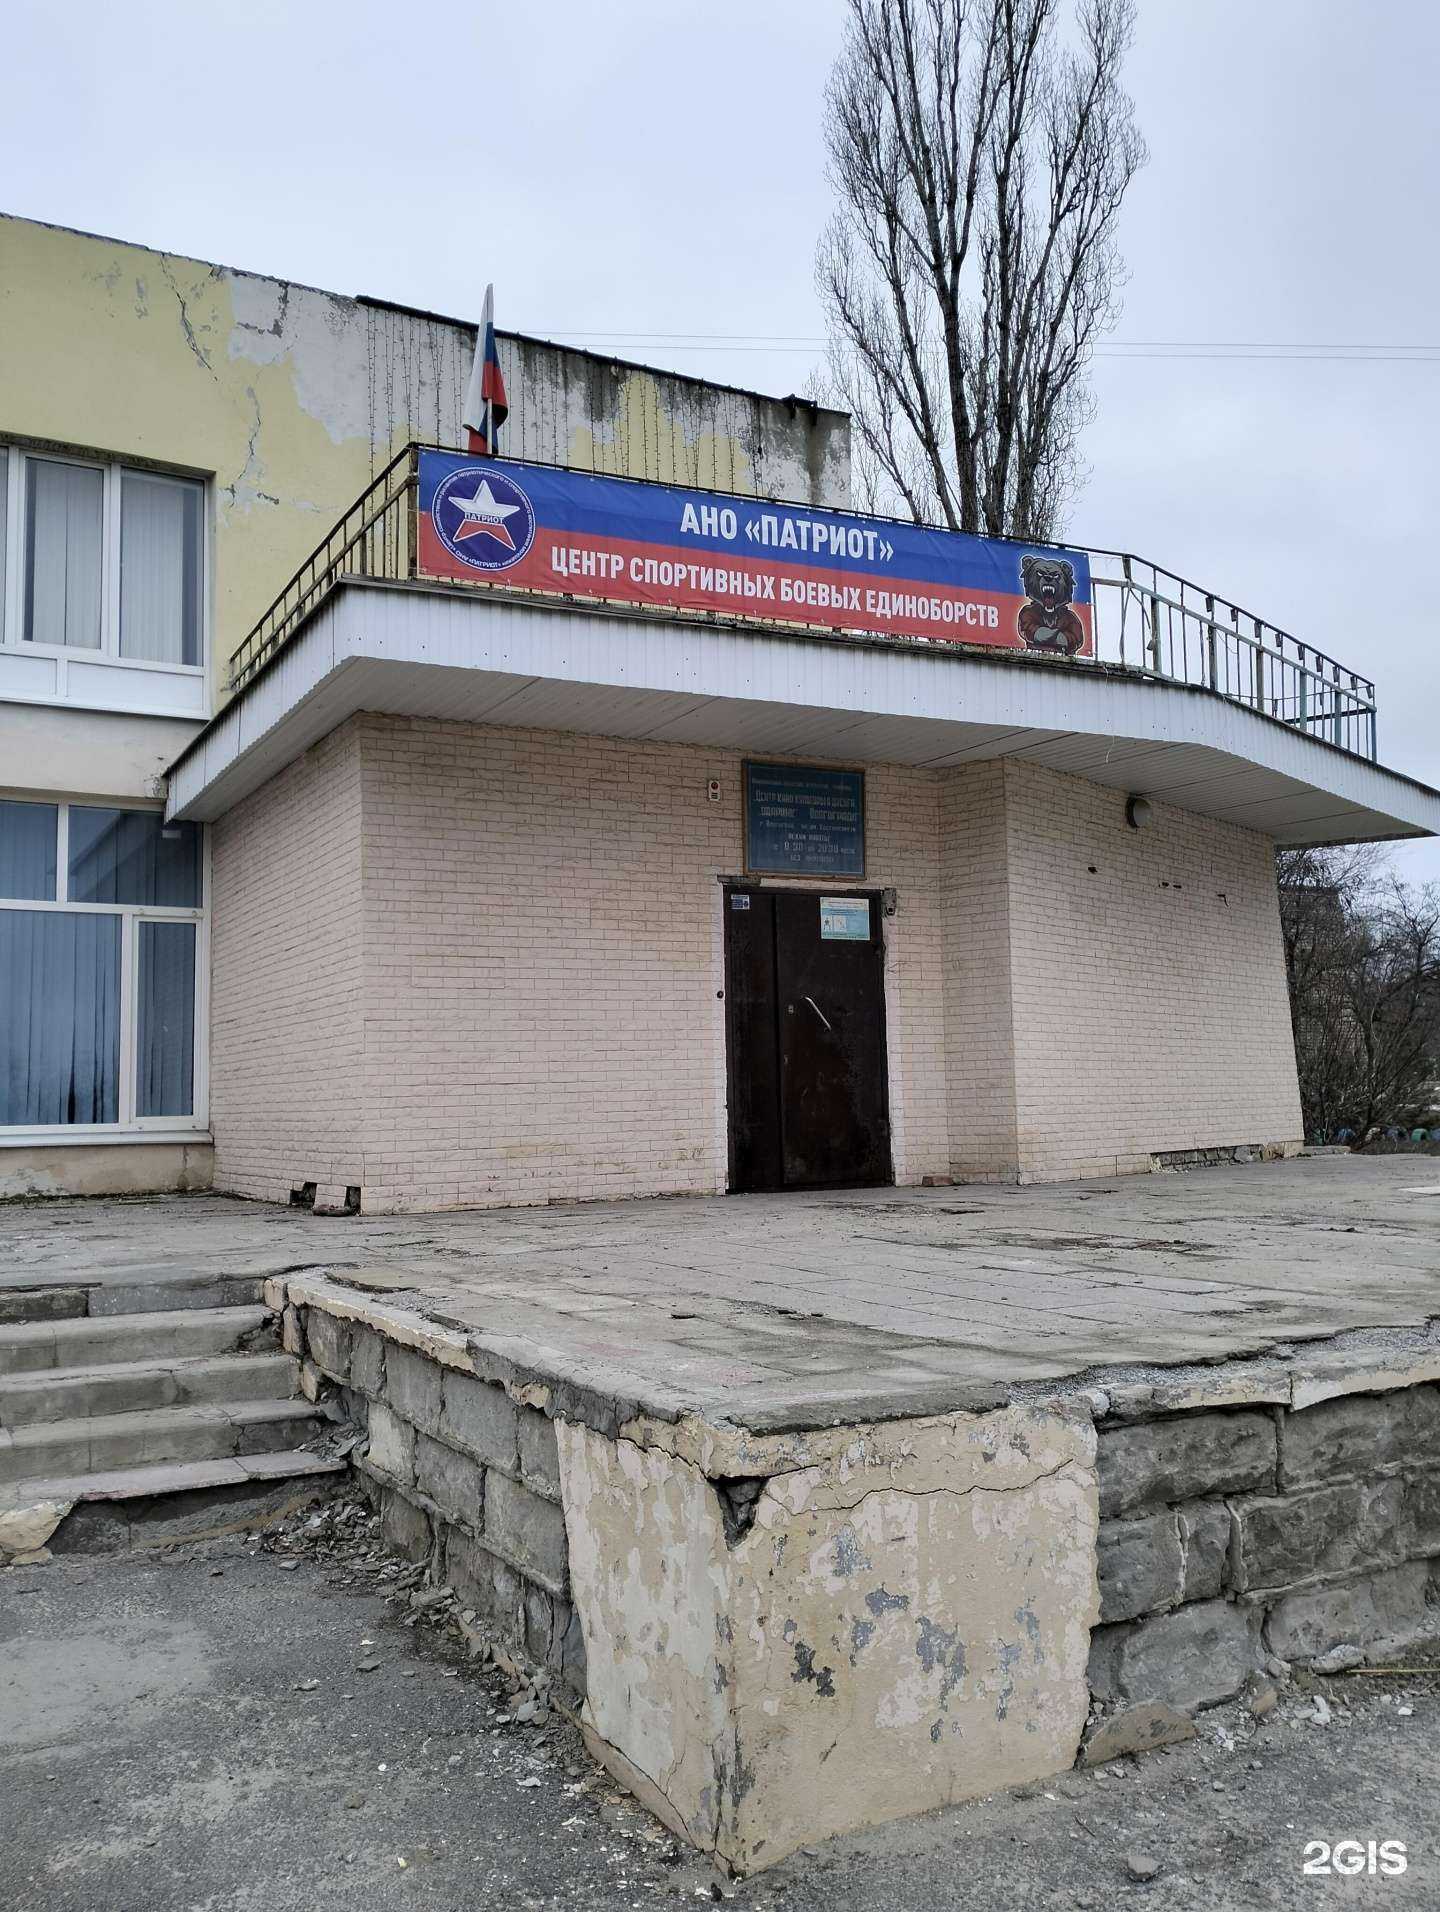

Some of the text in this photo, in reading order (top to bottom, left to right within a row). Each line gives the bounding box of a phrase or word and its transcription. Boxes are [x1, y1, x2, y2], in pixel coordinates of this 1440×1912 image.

[464, 512, 505, 524] ПАТРИОТ
[680, 503, 894, 562] АНО «ПАТРИОТ»
[551, 546, 624, 579] ЦЕНТР
[629, 557, 775, 600] СПОРТИВНЫХ
[780, 578, 861, 612] БОЕВЫХ
[866, 589, 999, 628] ЕДИНОБОРСТВ
